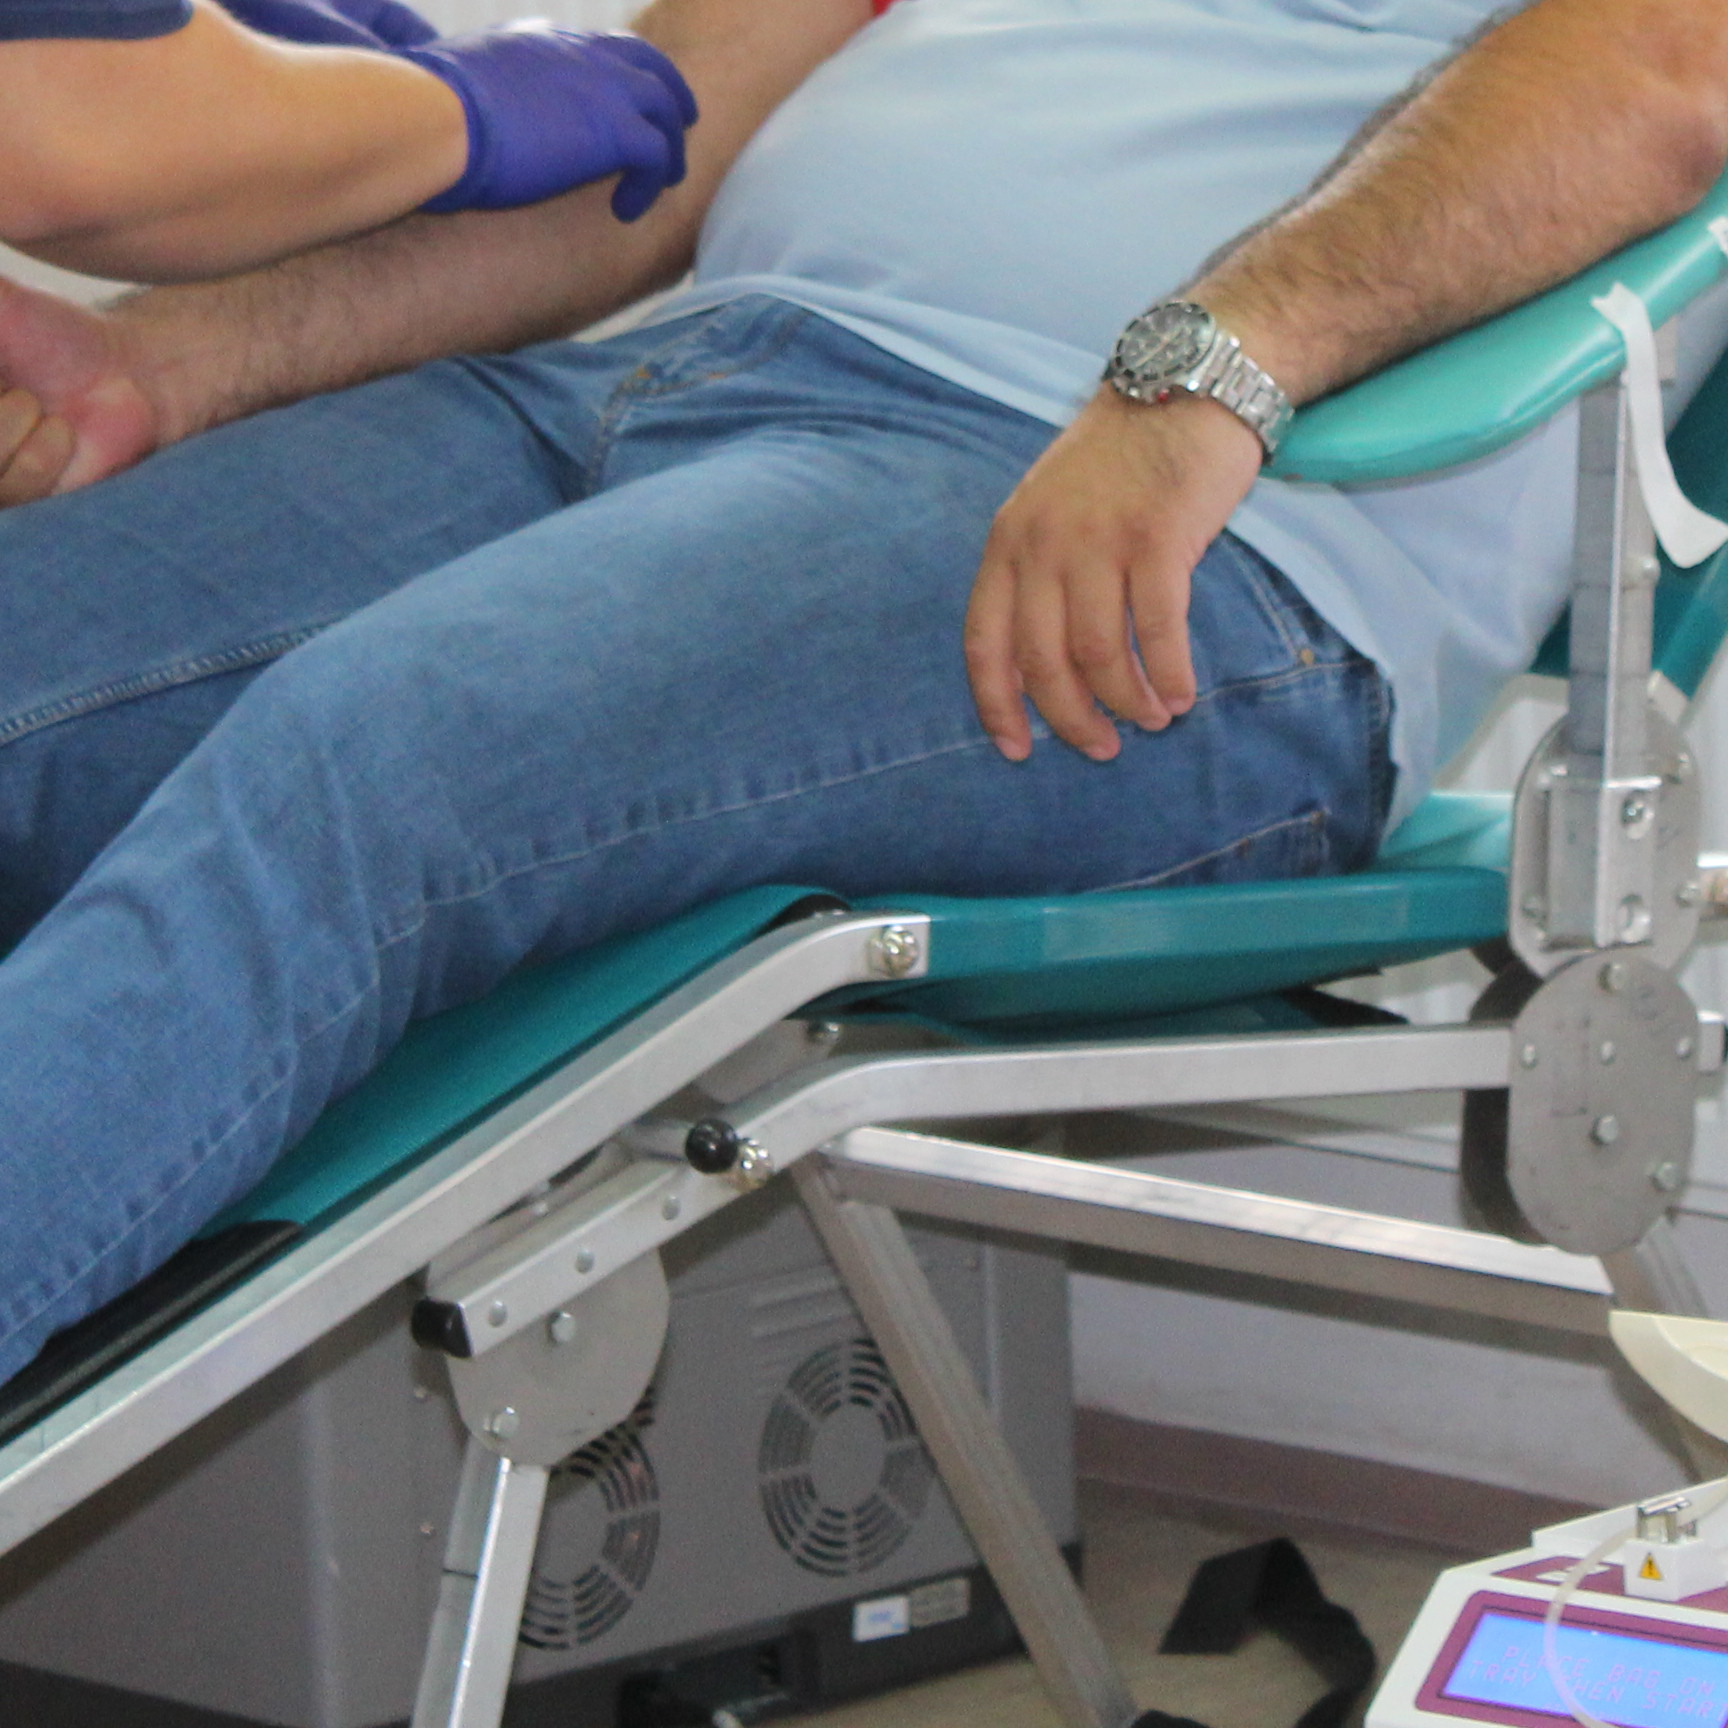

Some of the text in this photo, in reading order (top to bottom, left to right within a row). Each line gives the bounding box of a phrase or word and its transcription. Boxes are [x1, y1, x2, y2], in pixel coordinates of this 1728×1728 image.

[1470, 1660, 1537, 1687] TRAY
[1609, 1664, 1660, 1689] BAG
[1680, 1676, 1716, 1697] ON
